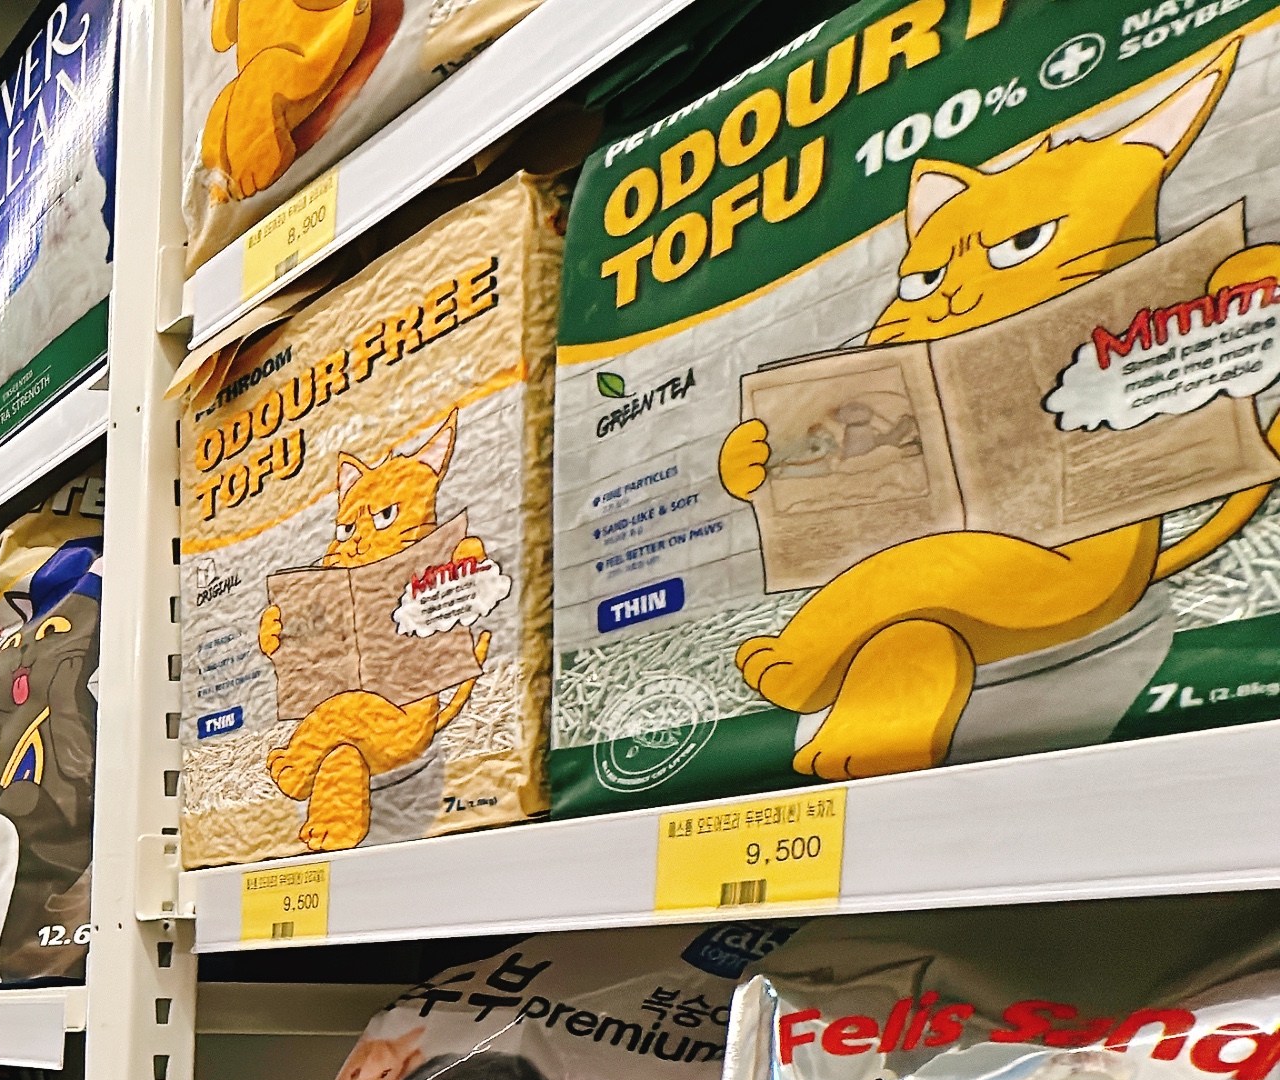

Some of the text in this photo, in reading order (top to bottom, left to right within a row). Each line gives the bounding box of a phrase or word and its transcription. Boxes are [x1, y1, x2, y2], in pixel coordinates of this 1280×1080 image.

[603, 2, 945, 238] ODOUR
[854, 77, 1028, 178] 100%
[600, 135, 827, 310] TOFU
[1180, 316, 1278, 360] particles
[194, 257, 500, 474] ODOUR FREE
[1124, 338, 1274, 393] make me more
[1130, 359, 1264, 410] comfortable
[10, 374, 51, 420] STRENGTH
[195, 427, 307, 522] TOFU
[610, 588, 667, 622] THIN
[1145, 682, 1205, 715] 7L
[205, 713, 236, 733] THIN
[443, 796, 467, 814] 7L
[746, 835, 822, 865] 9,500
[282, 893, 320, 913] 9,500
[778, 989, 975, 1067] Felis
